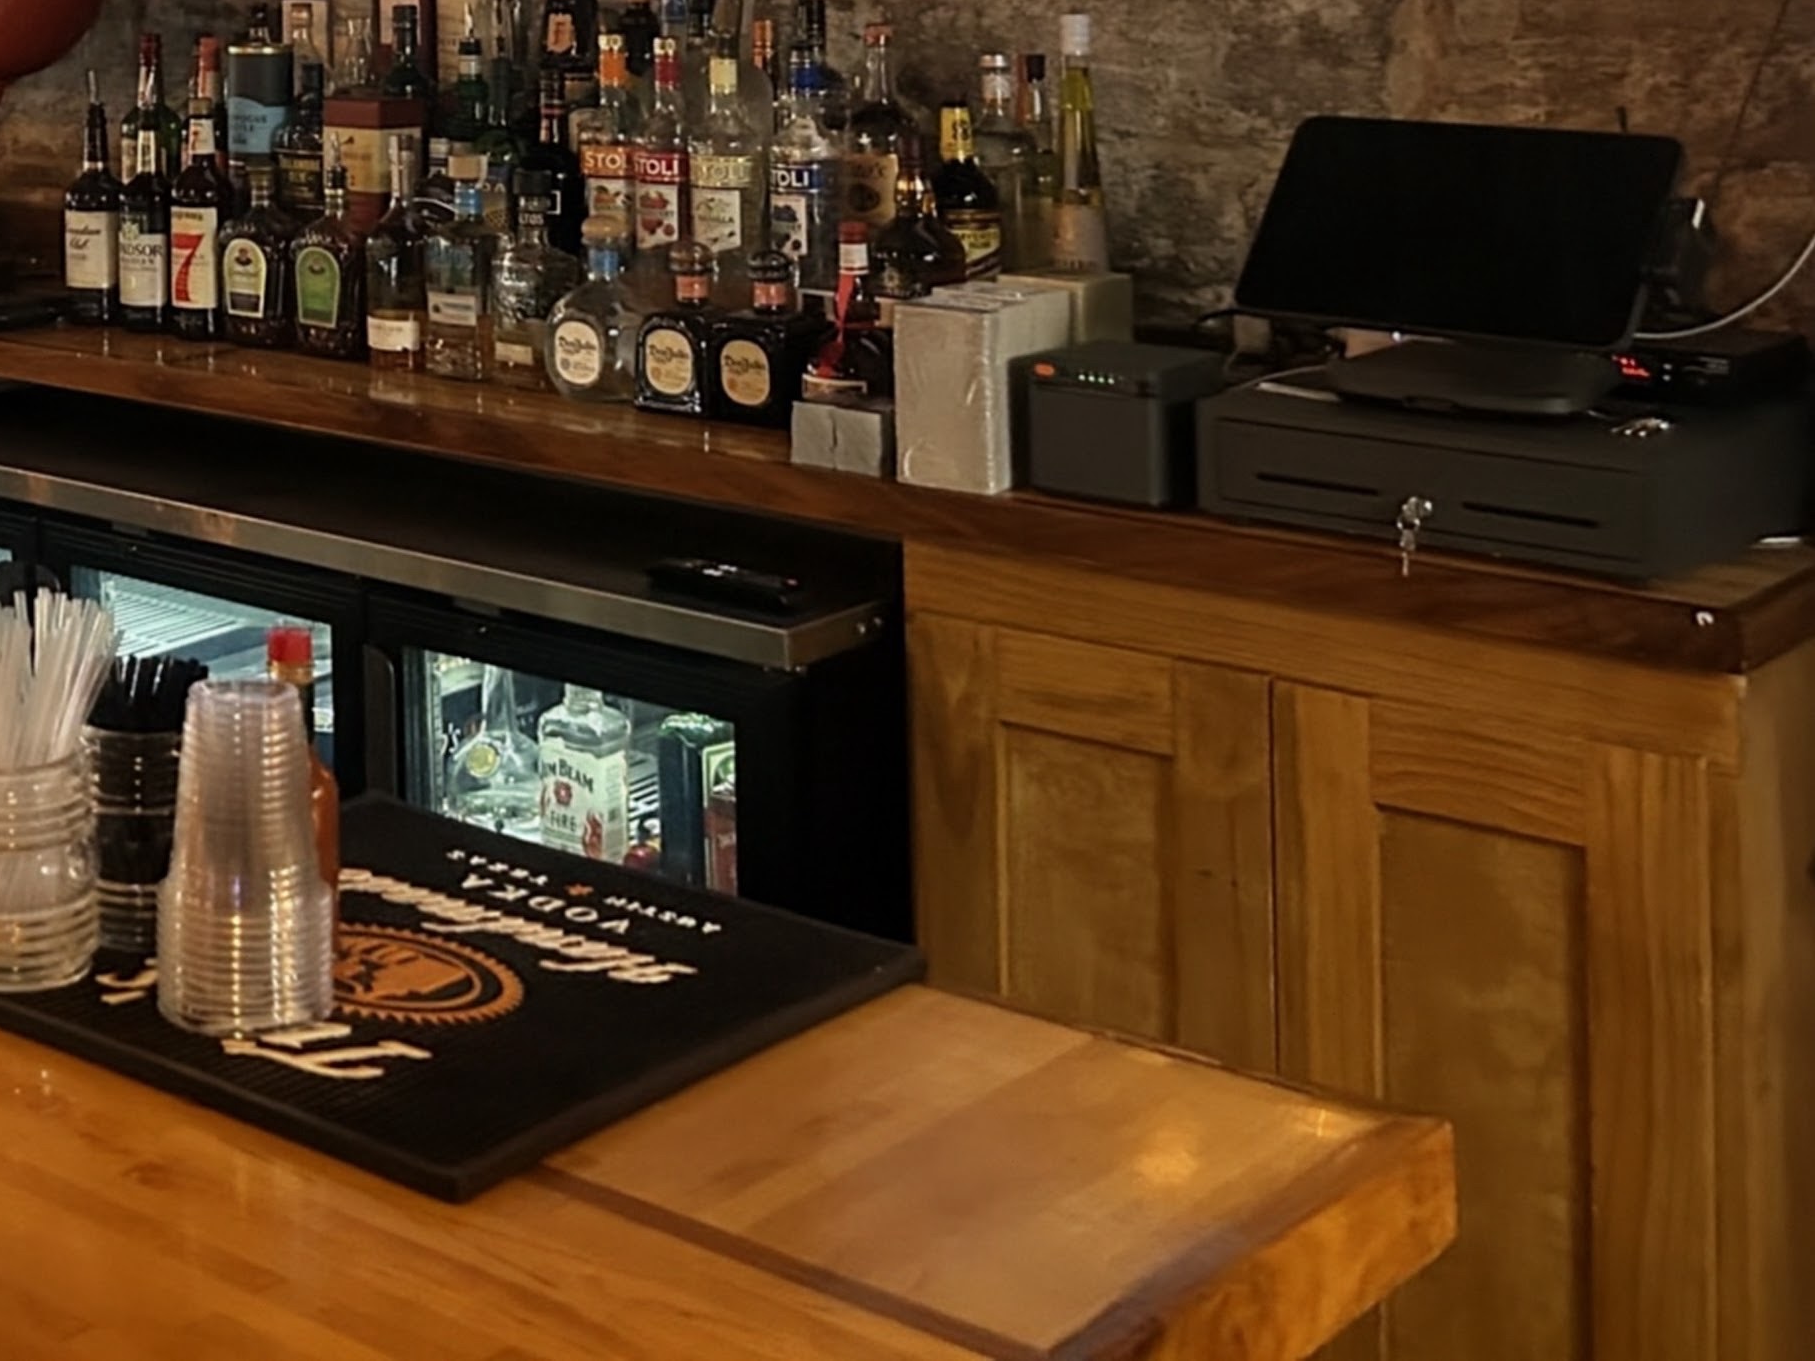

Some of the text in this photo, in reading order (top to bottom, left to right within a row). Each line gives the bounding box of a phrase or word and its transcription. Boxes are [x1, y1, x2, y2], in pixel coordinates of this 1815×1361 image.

[172, 232, 205, 303] 7
[445, 848, 723, 935] AUSTIN TEXAS
[460, 872, 631, 935] VODKA
